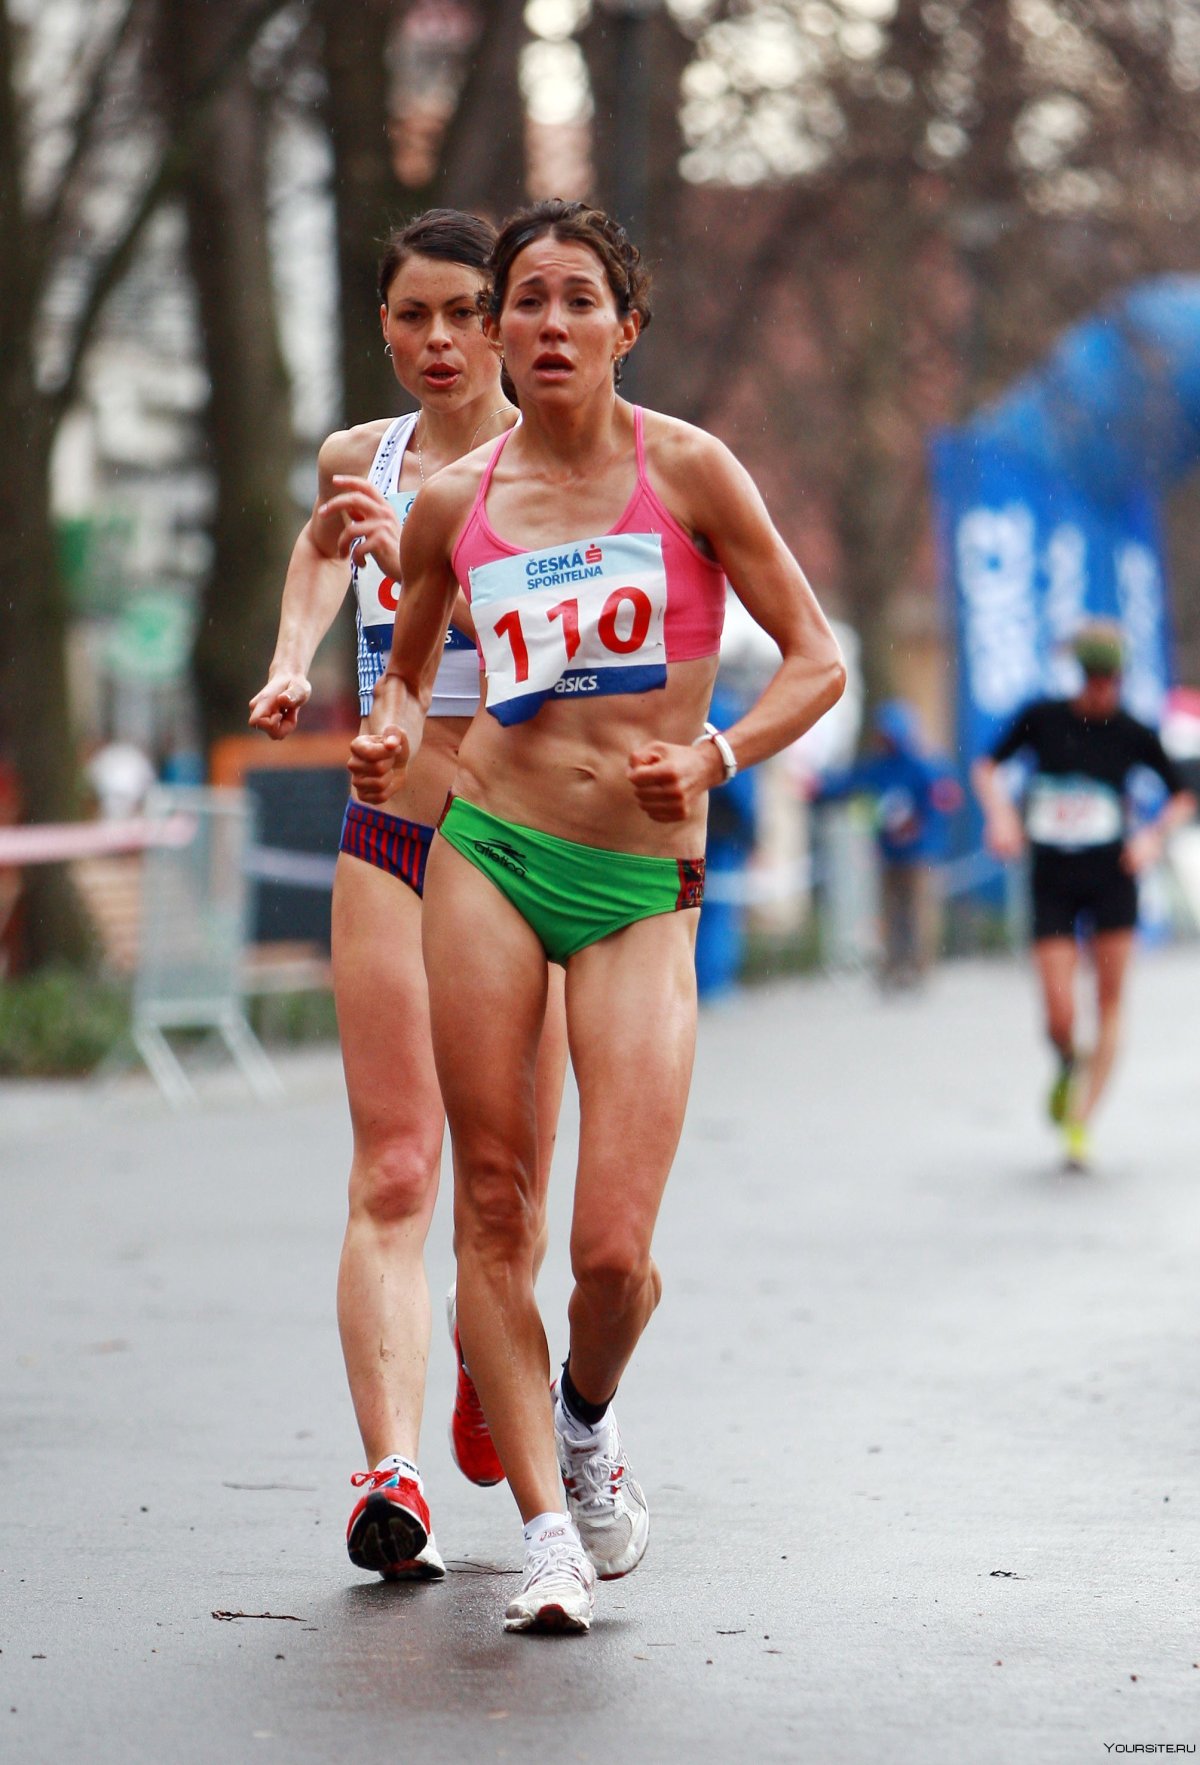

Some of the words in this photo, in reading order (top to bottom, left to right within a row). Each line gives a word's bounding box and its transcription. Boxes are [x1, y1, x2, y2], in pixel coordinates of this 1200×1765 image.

[525, 548, 584, 576] ČESKÁ
[527, 565, 603, 590] SPOŘITELNA
[493, 586, 652, 684] 110
[554, 675, 598, 693] asics
